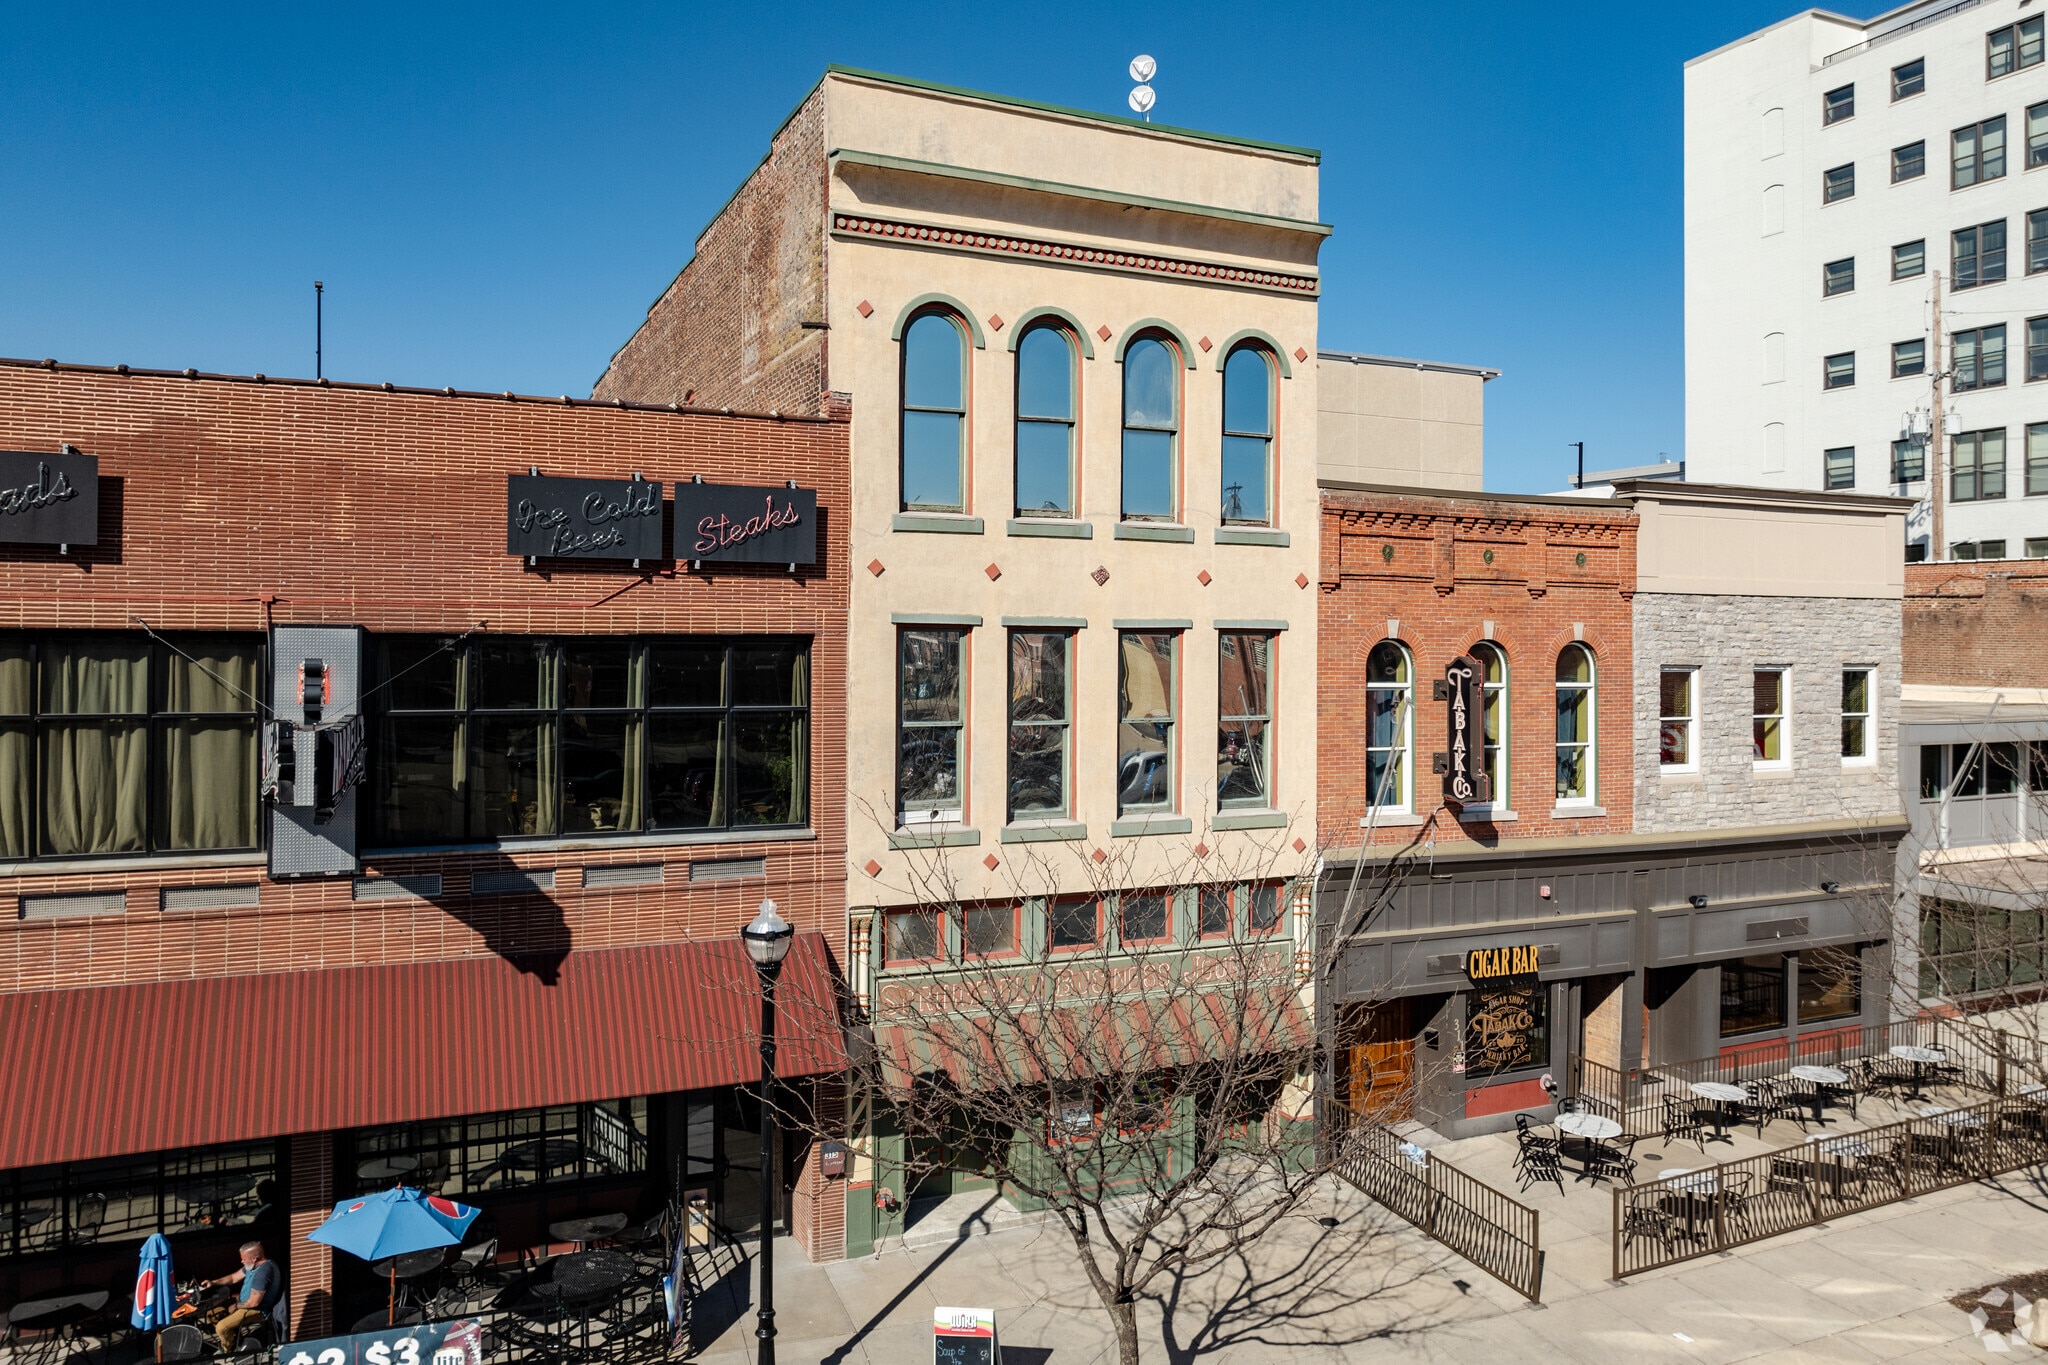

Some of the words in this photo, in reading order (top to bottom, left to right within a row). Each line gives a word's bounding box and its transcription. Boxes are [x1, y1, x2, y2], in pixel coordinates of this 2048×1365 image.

[515, 498, 568, 529] Ice
[582, 483, 655, 521] Cold
[551, 523, 623, 554] Beer
[695, 495, 799, 552] Steaks
[1447, 668, 1472, 773] TABAK
[1470, 948, 1510, 979] CIGAR
[1512, 945, 1538, 975] BAR
[365, 1336, 420, 1365] $3
[936, 1339, 956, 1358] Soup
